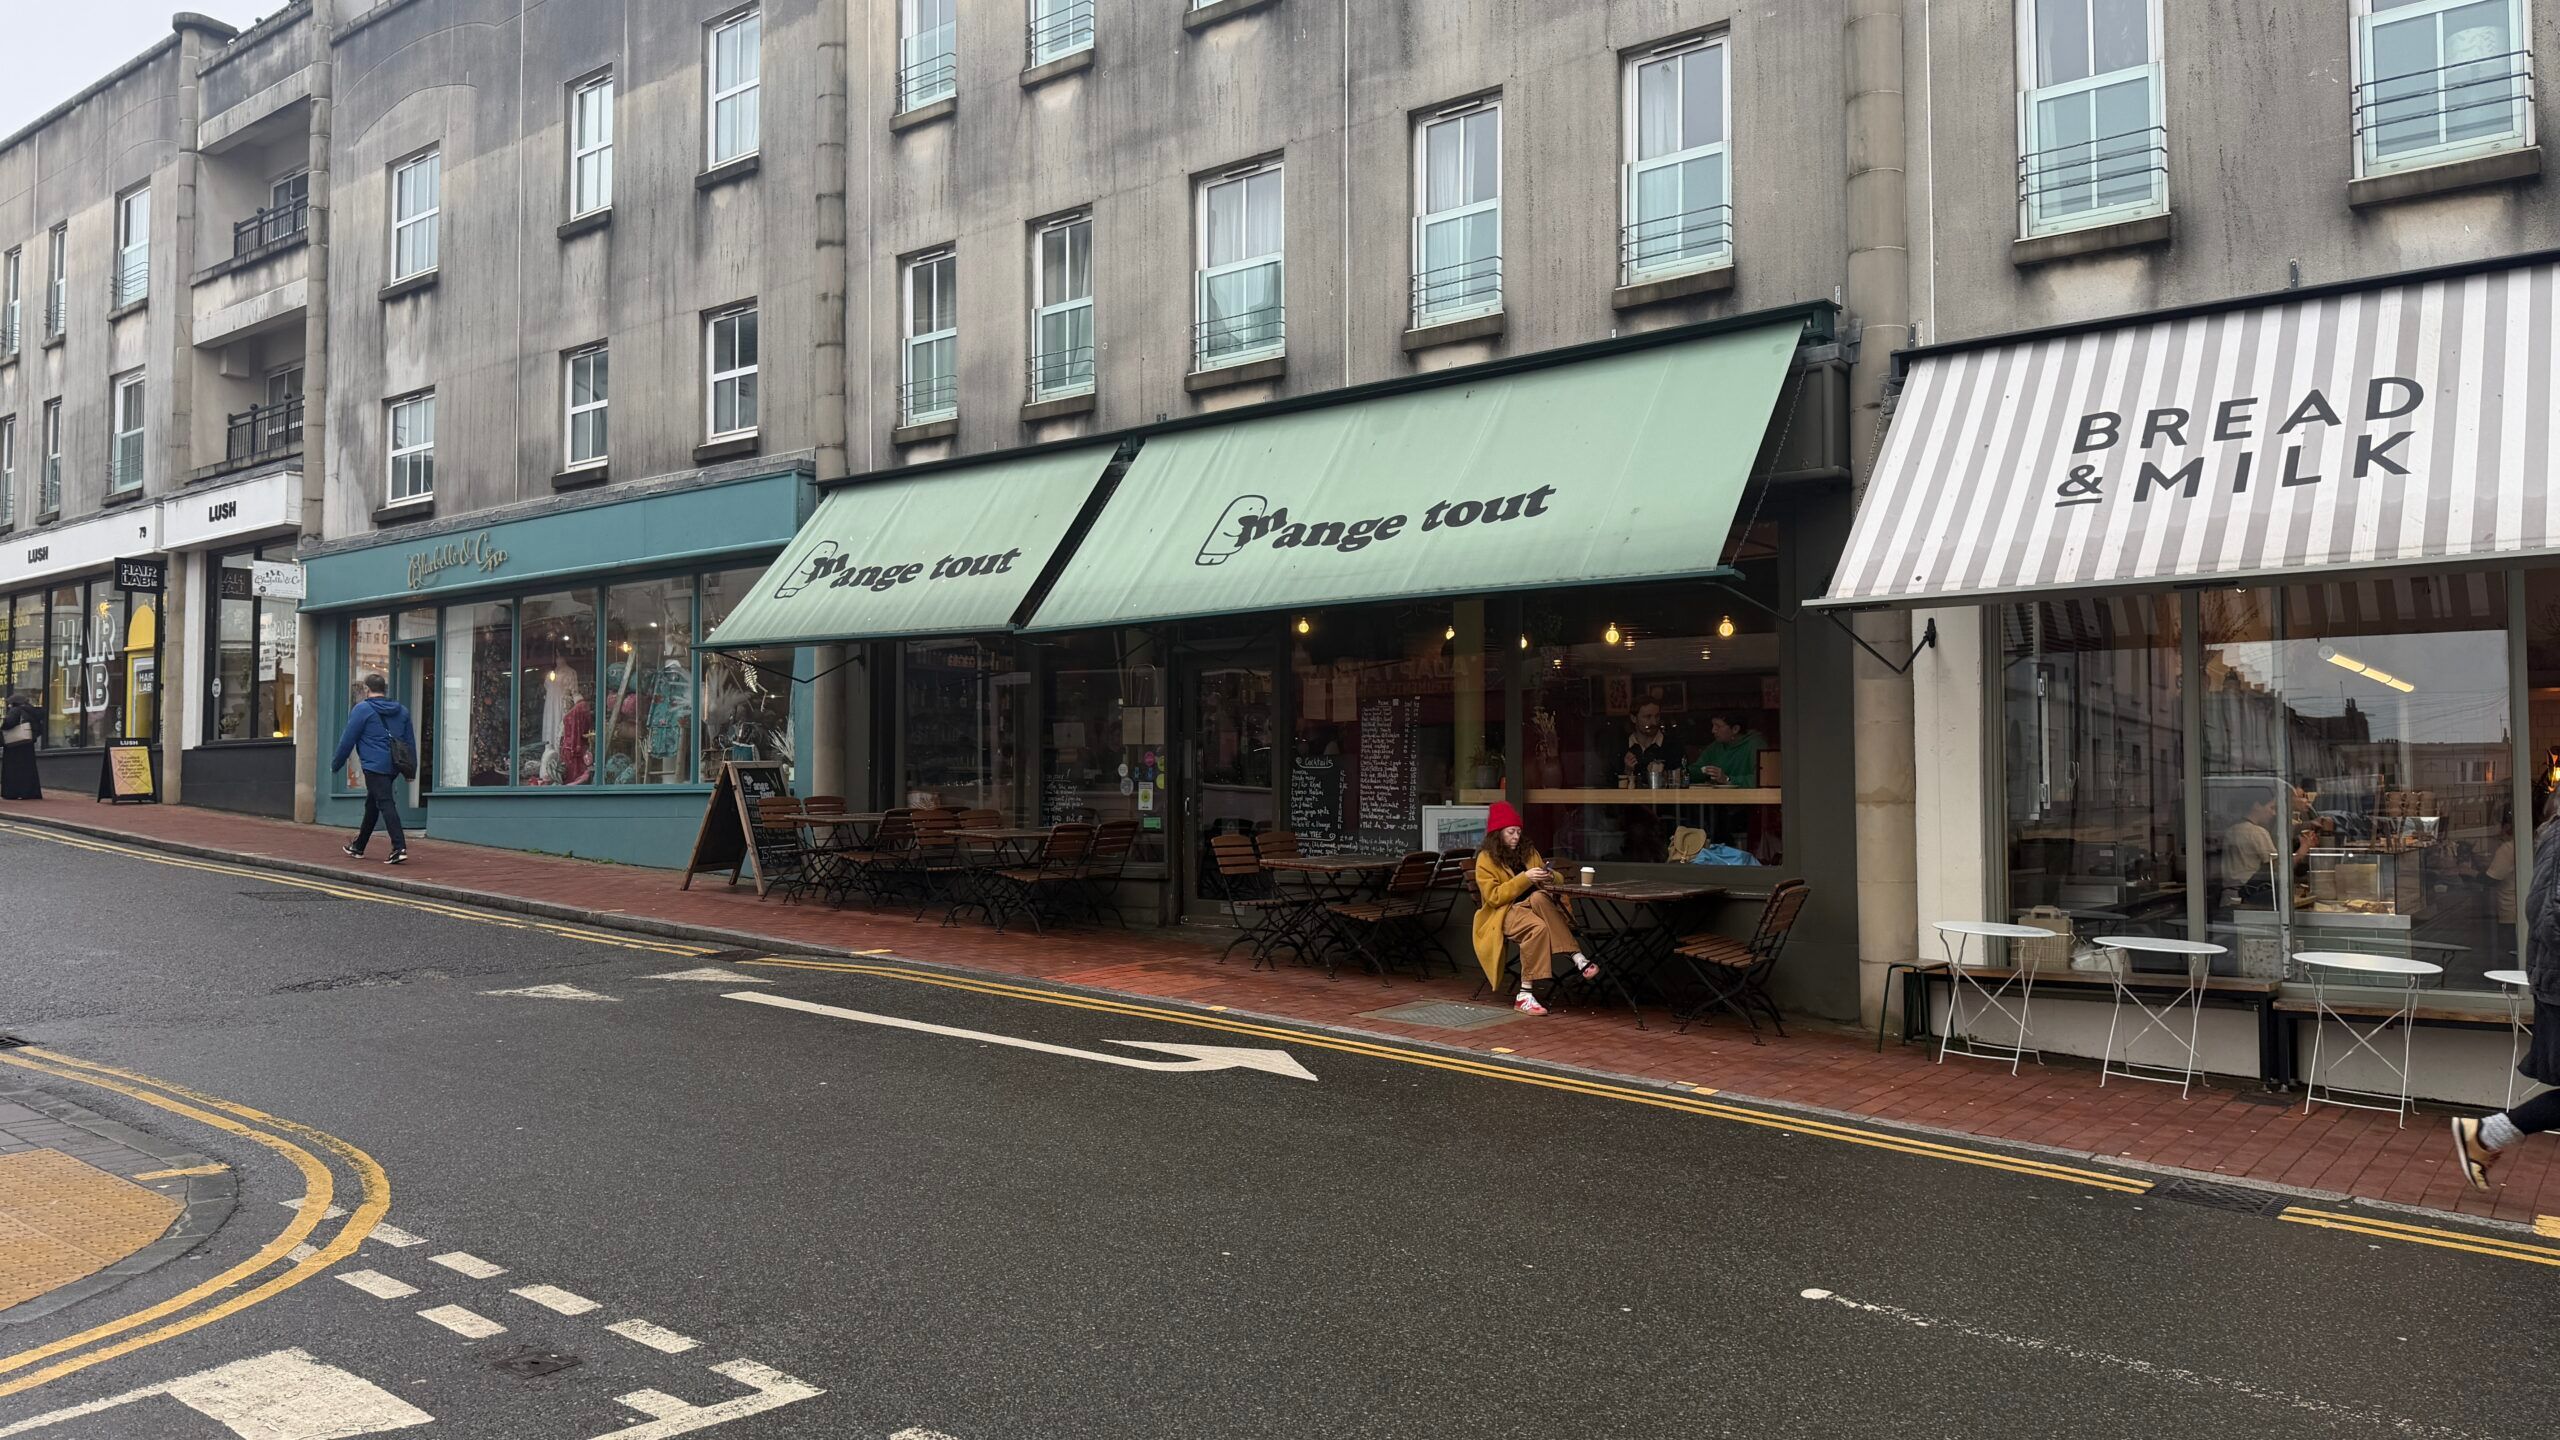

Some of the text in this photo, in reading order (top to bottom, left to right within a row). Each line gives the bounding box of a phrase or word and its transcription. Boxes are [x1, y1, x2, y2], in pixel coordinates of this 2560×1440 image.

[2072, 376, 2424, 455] BREAD
[2055, 430, 2416, 508] & MILK
[209, 501, 237, 523] LUSH
[1421, 483, 1556, 532] tout
[139, 526, 147, 539] 79
[28, 546, 48, 564] LUSH
[930, 547, 1022, 580] tout
[121, 564, 157, 578] HAIR
[121, 574, 150, 587] LAB
[58, 614, 116, 667] HAIR
[62, 663, 110, 715] LAB
[139, 683, 152, 692] LAB
